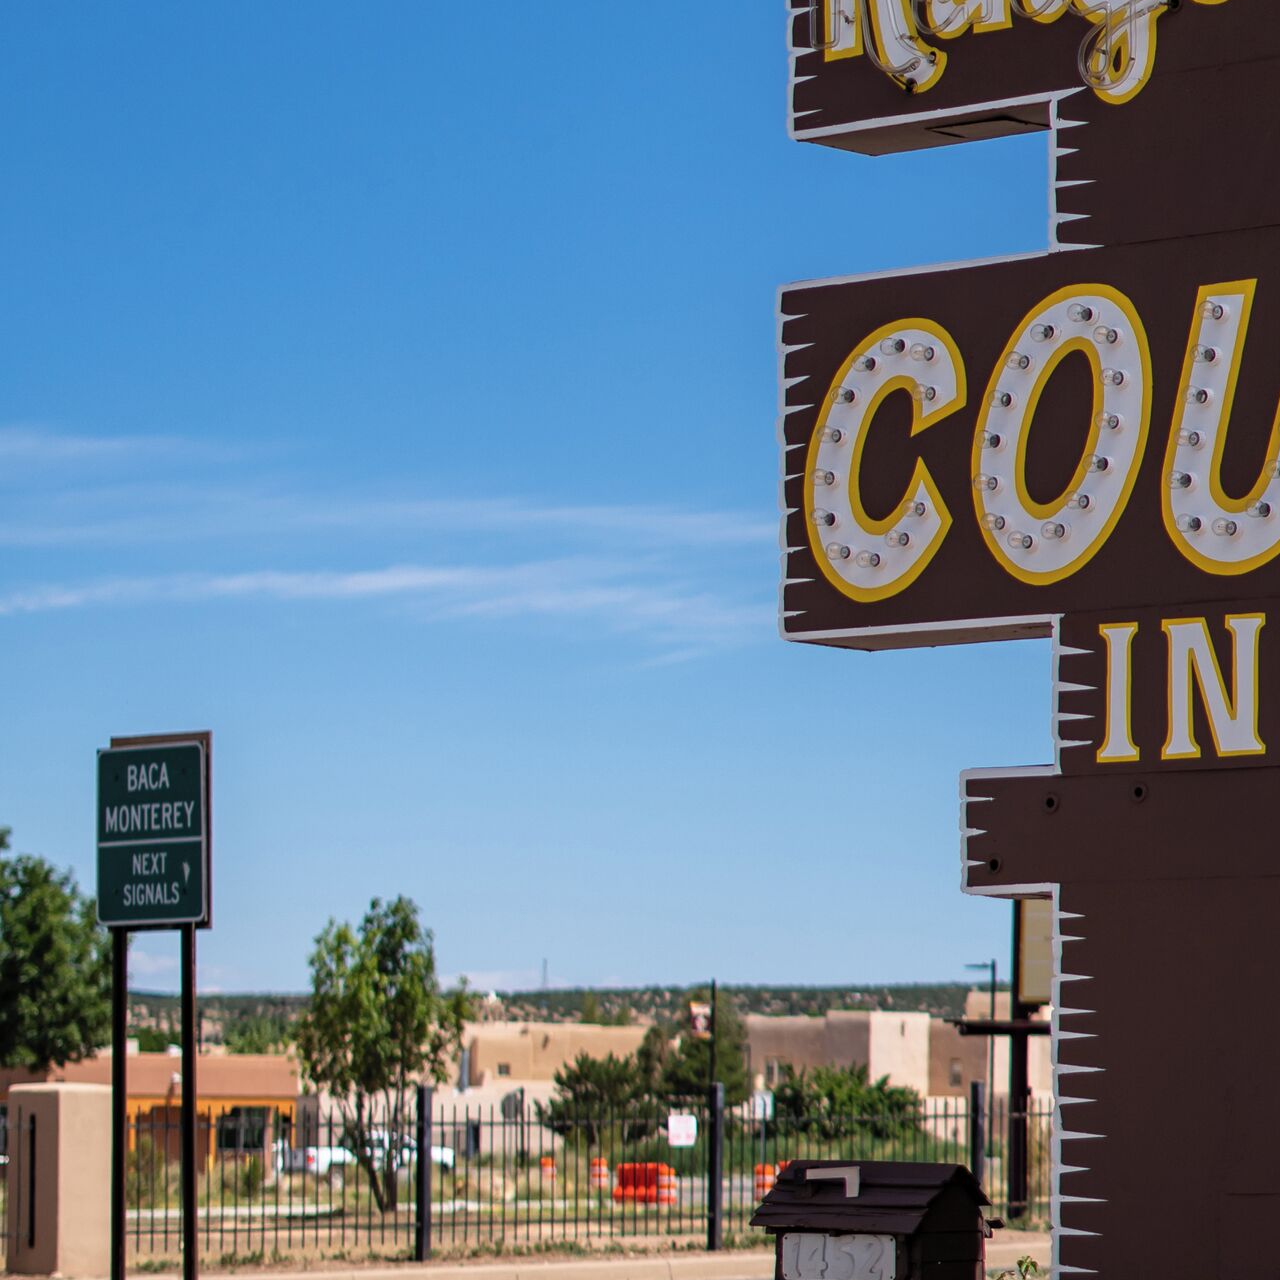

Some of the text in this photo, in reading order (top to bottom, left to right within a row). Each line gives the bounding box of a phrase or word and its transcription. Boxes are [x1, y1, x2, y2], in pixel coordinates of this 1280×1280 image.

[127, 762, 170, 792] BACA
[105, 800, 195, 833] MONTEREY
[132, 852, 168, 876] NEXT
[123, 882, 180, 907] SIGNALS
